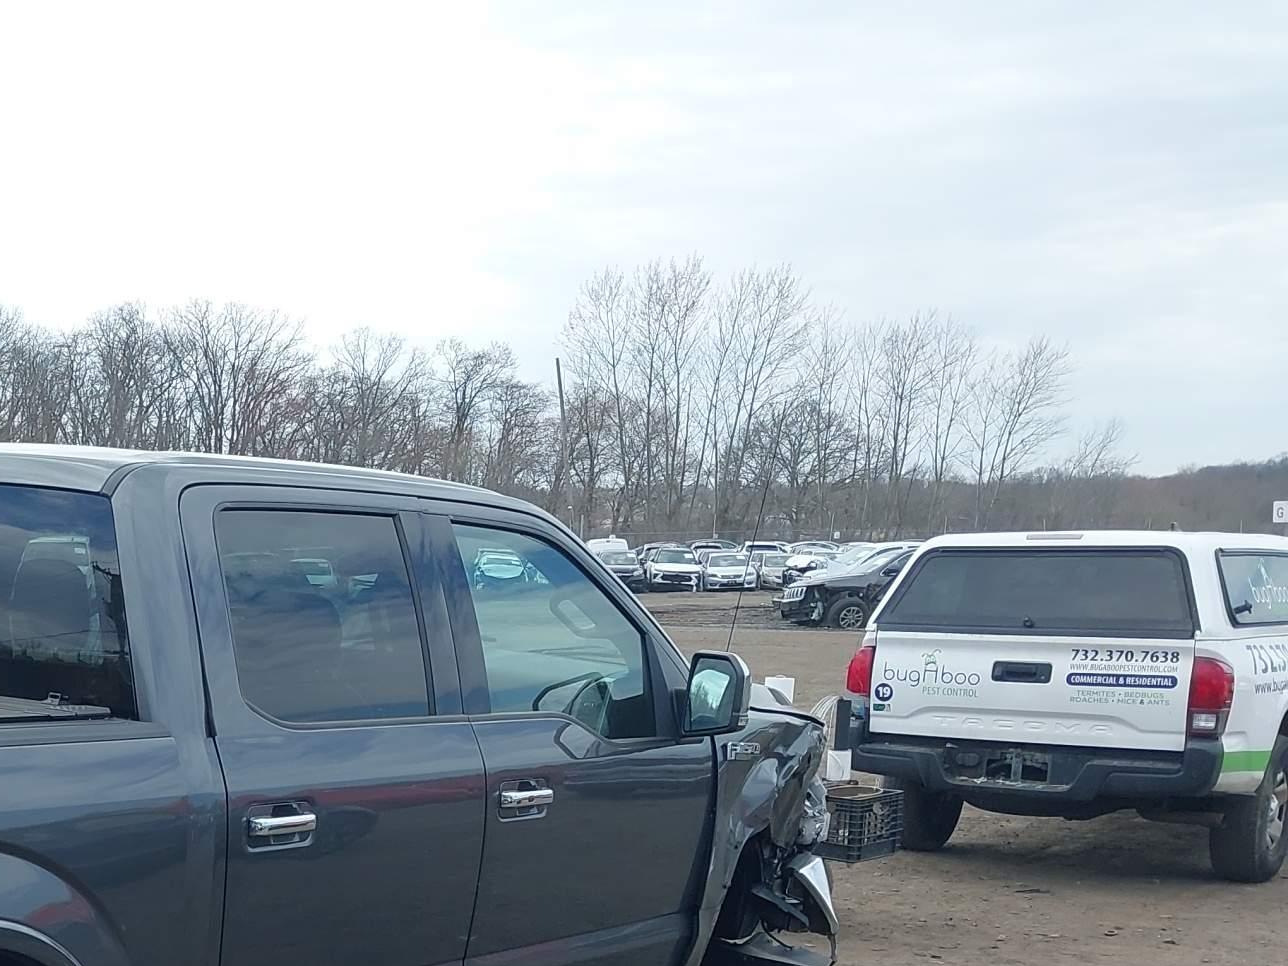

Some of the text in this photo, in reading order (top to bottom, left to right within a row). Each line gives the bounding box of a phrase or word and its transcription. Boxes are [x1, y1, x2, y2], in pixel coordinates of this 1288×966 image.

[1276, 506, 1284, 519] G
[1071, 648, 1180, 663] 732.370.7638
[1070, 675, 1117, 685] COMMERCIAL
[1125, 677, 1173, 686] RESIDENTIAL
[877, 685, 890, 698] 19
[922, 686, 978, 698] PEST CONTROL
[1076, 690, 1165, 699] TERMITES BEDBUGS
[931, 715, 1114, 736] TACOMA
